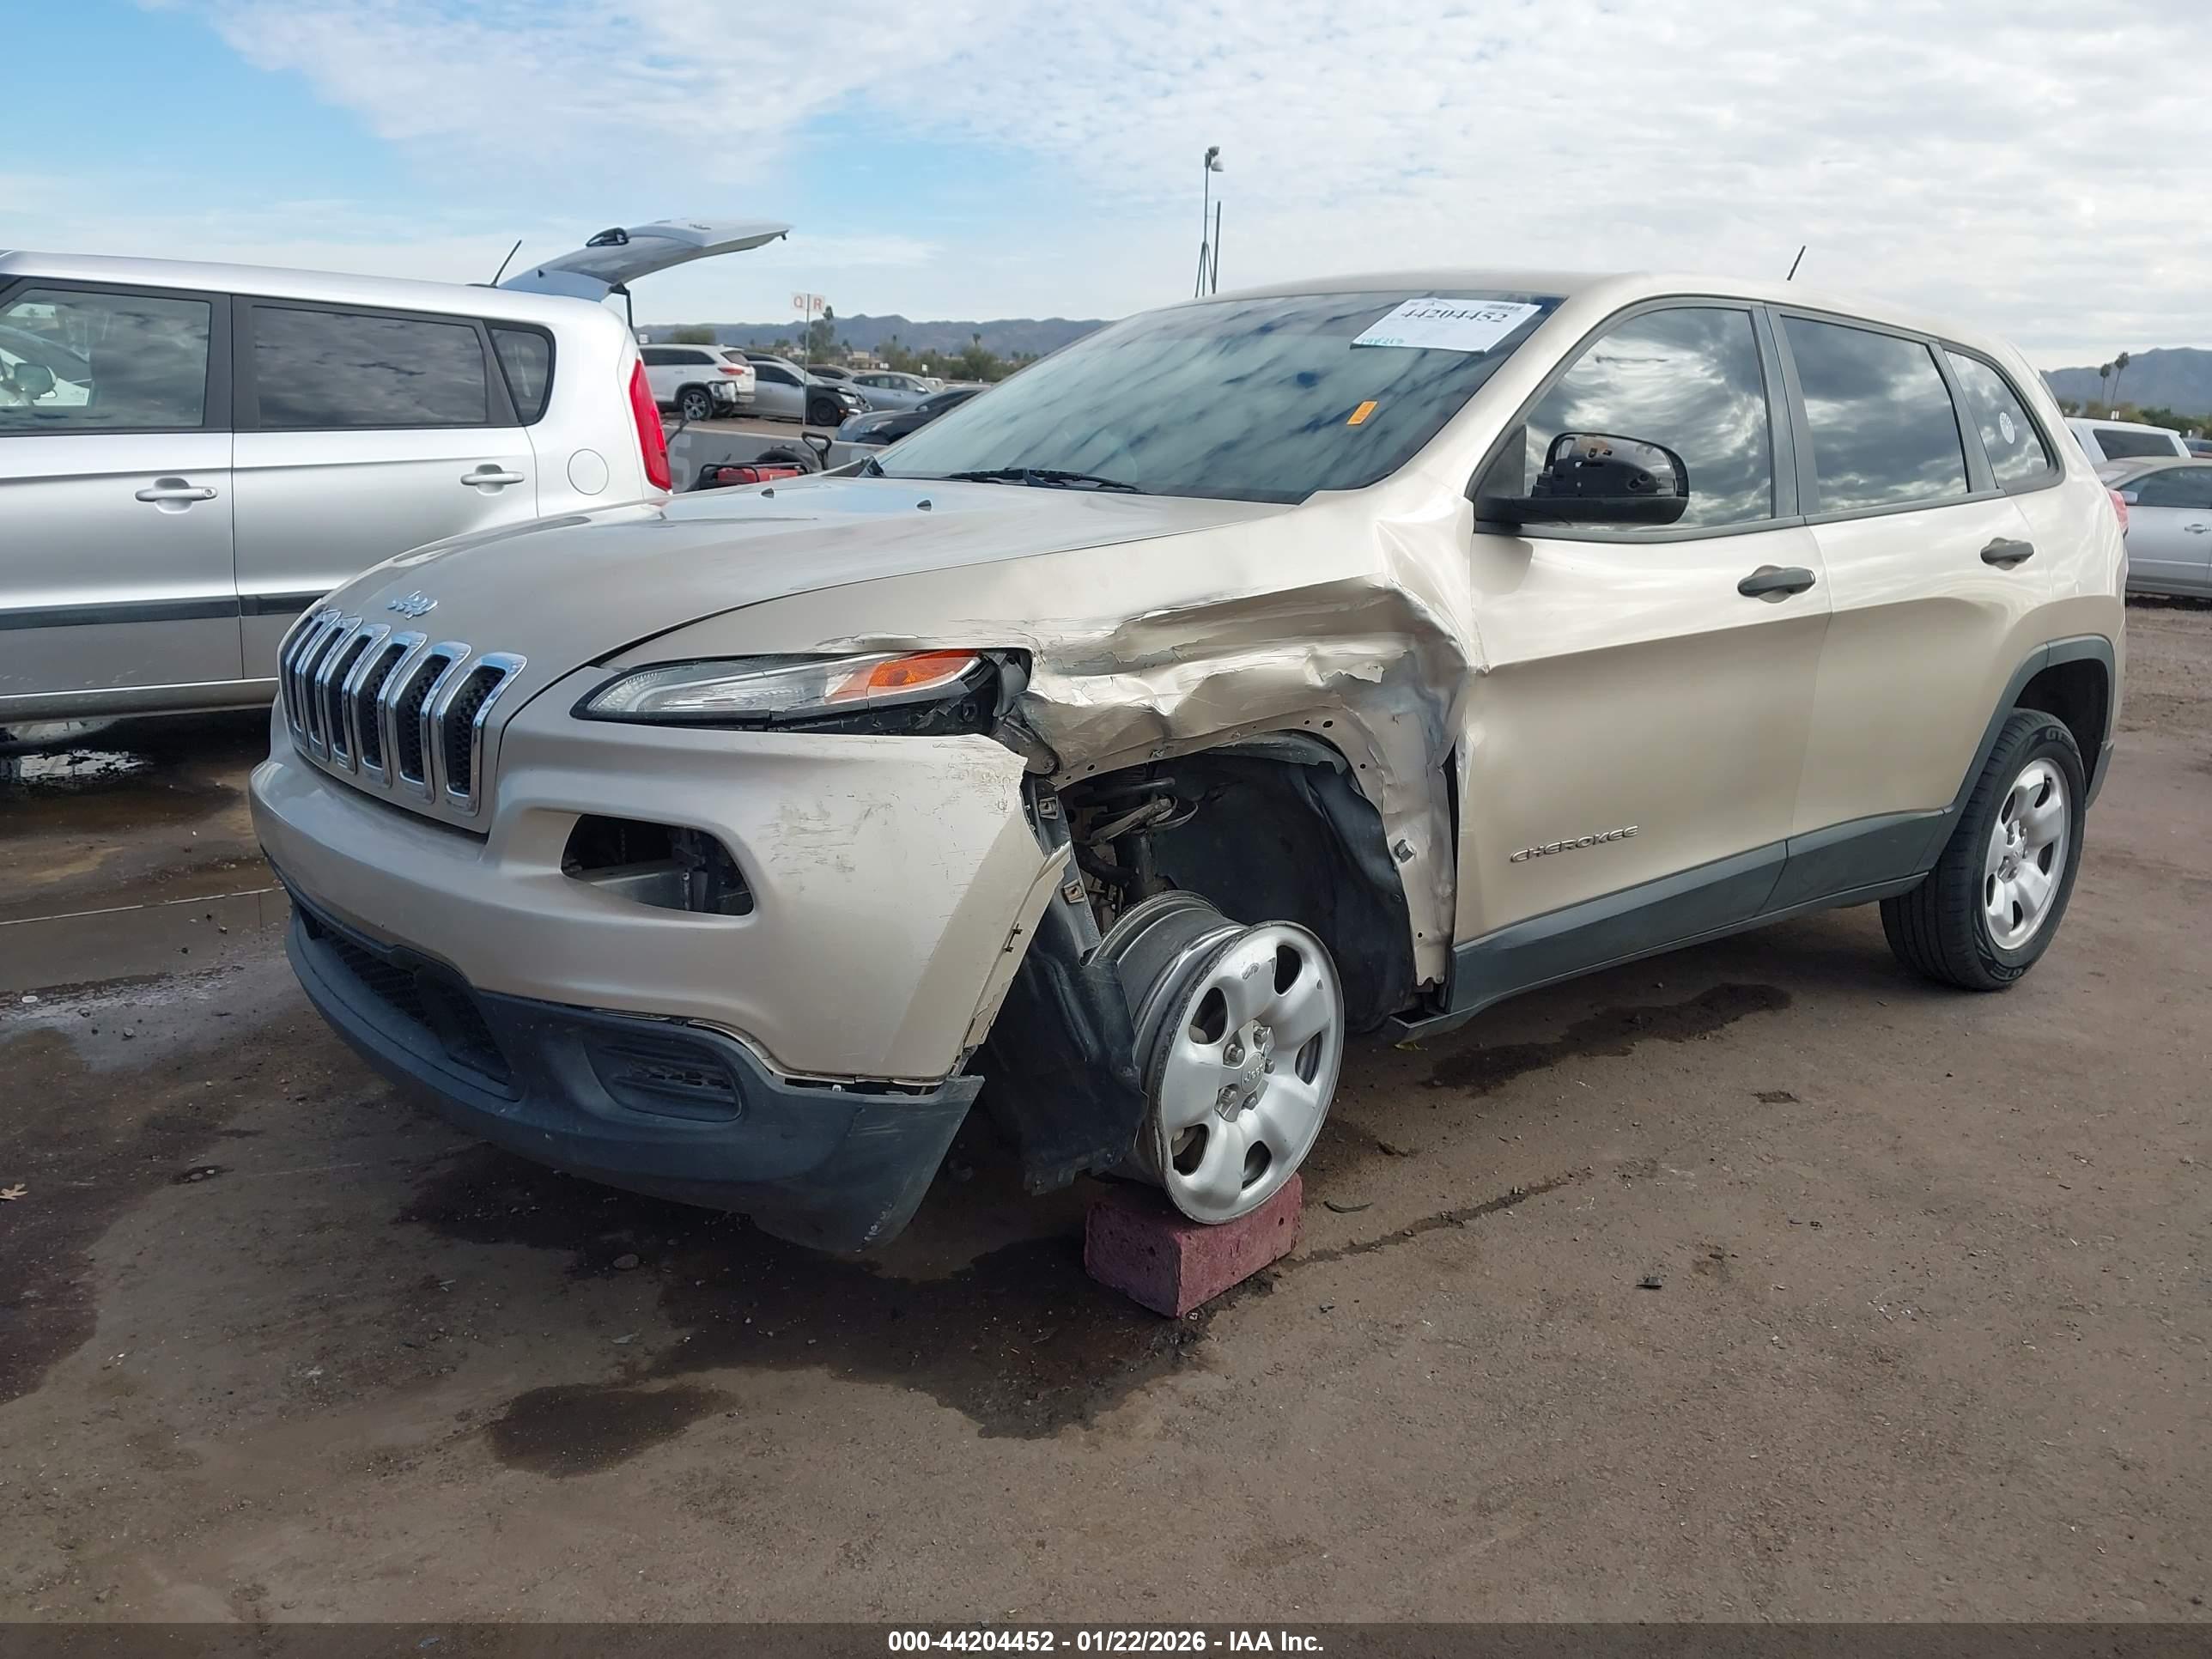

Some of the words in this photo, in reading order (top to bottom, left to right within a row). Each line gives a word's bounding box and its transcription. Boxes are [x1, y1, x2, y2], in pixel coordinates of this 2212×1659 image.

[793, 295, 803, 308] Q
[813, 297, 822, 310] R
[1401, 308, 1509, 323] 44204452
[1510, 825, 1638, 863] CHEROKEE
